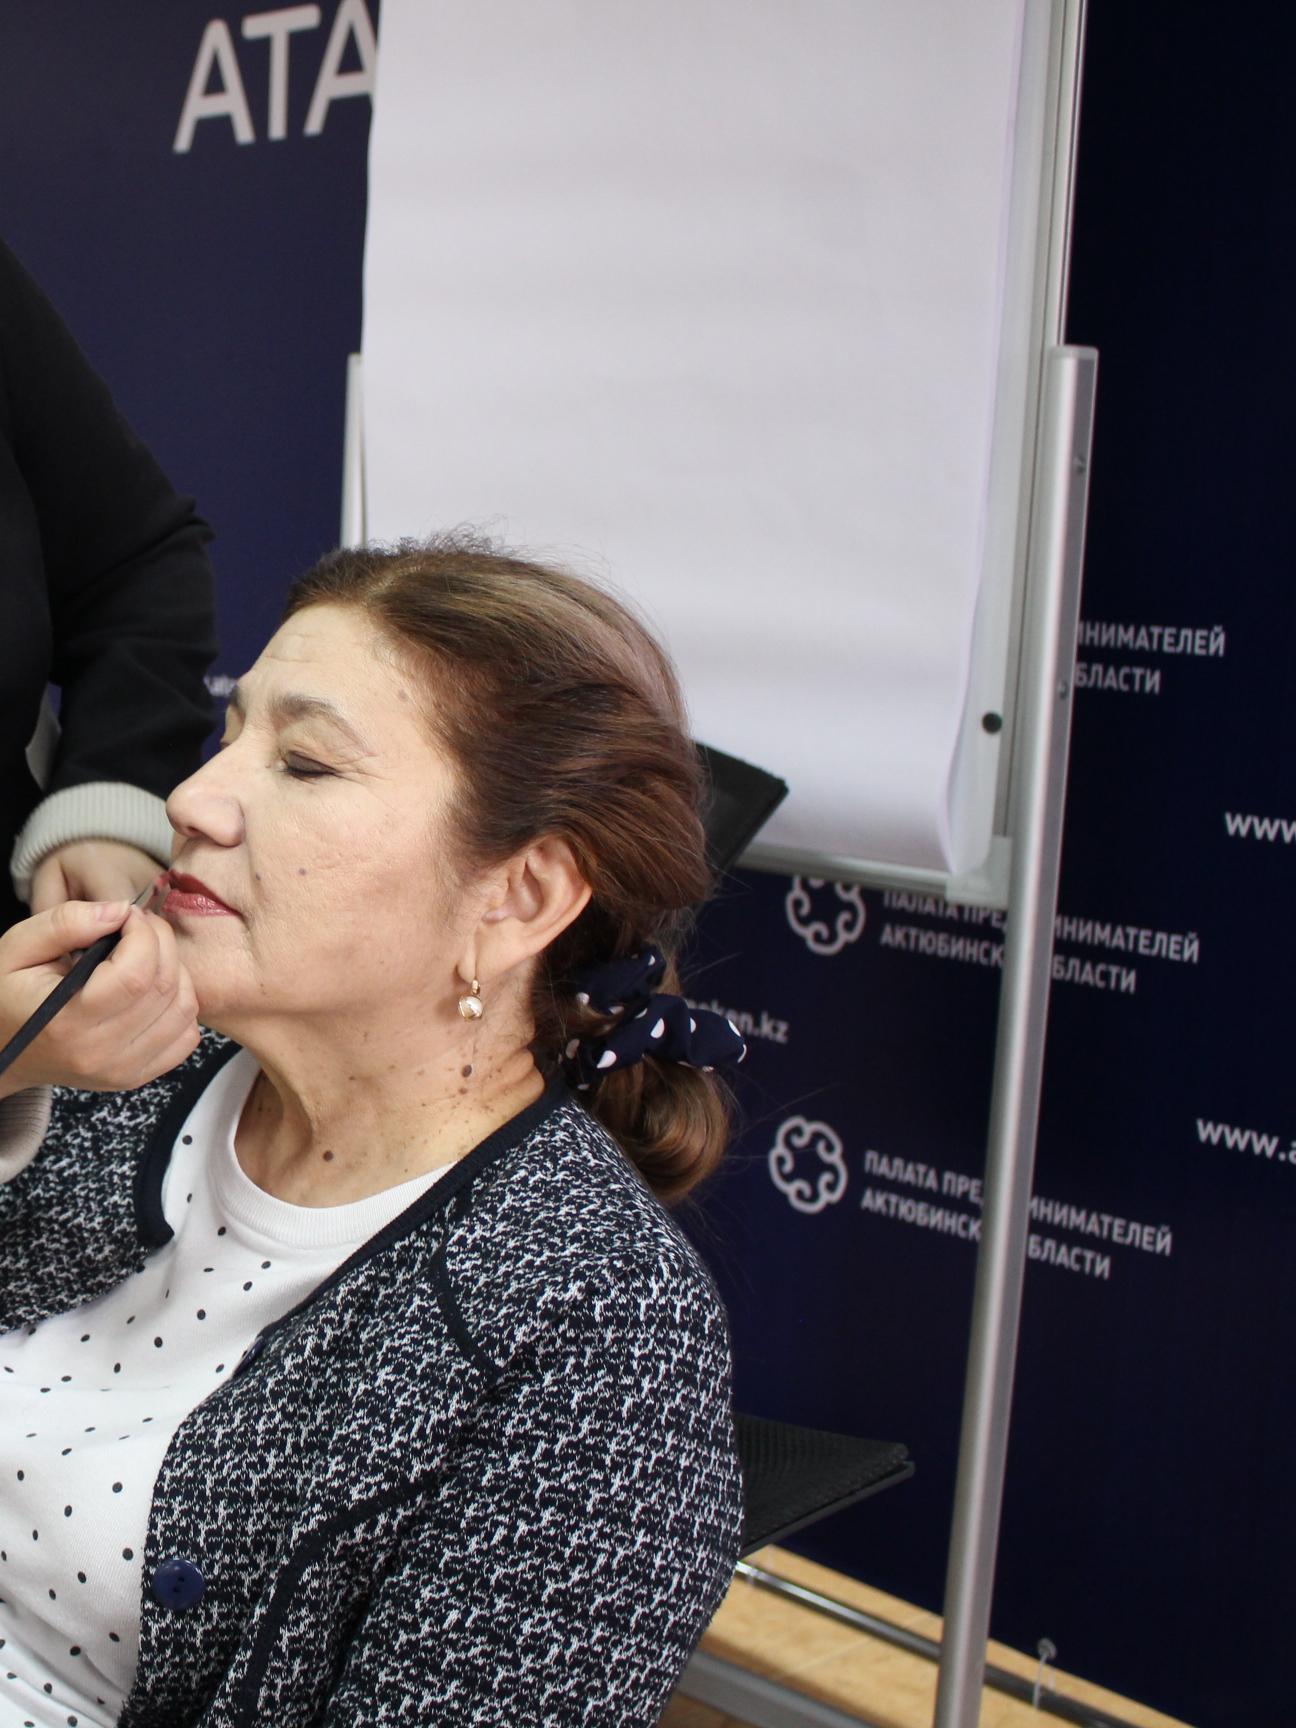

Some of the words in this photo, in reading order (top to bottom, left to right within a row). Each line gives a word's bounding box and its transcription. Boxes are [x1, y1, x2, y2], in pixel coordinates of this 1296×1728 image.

[1074, 662, 1161, 694] БЛАСТИ
[881, 923, 1005, 967] АКТЮБИНСК
[1053, 954, 1137, 994] БЛАСТИ
[865, 1149, 938, 1193] ПАЛАТА
[861, 1185, 982, 1242] АКТЮБИНСК
[1027, 1233, 1111, 1280] БЛАСТИ
